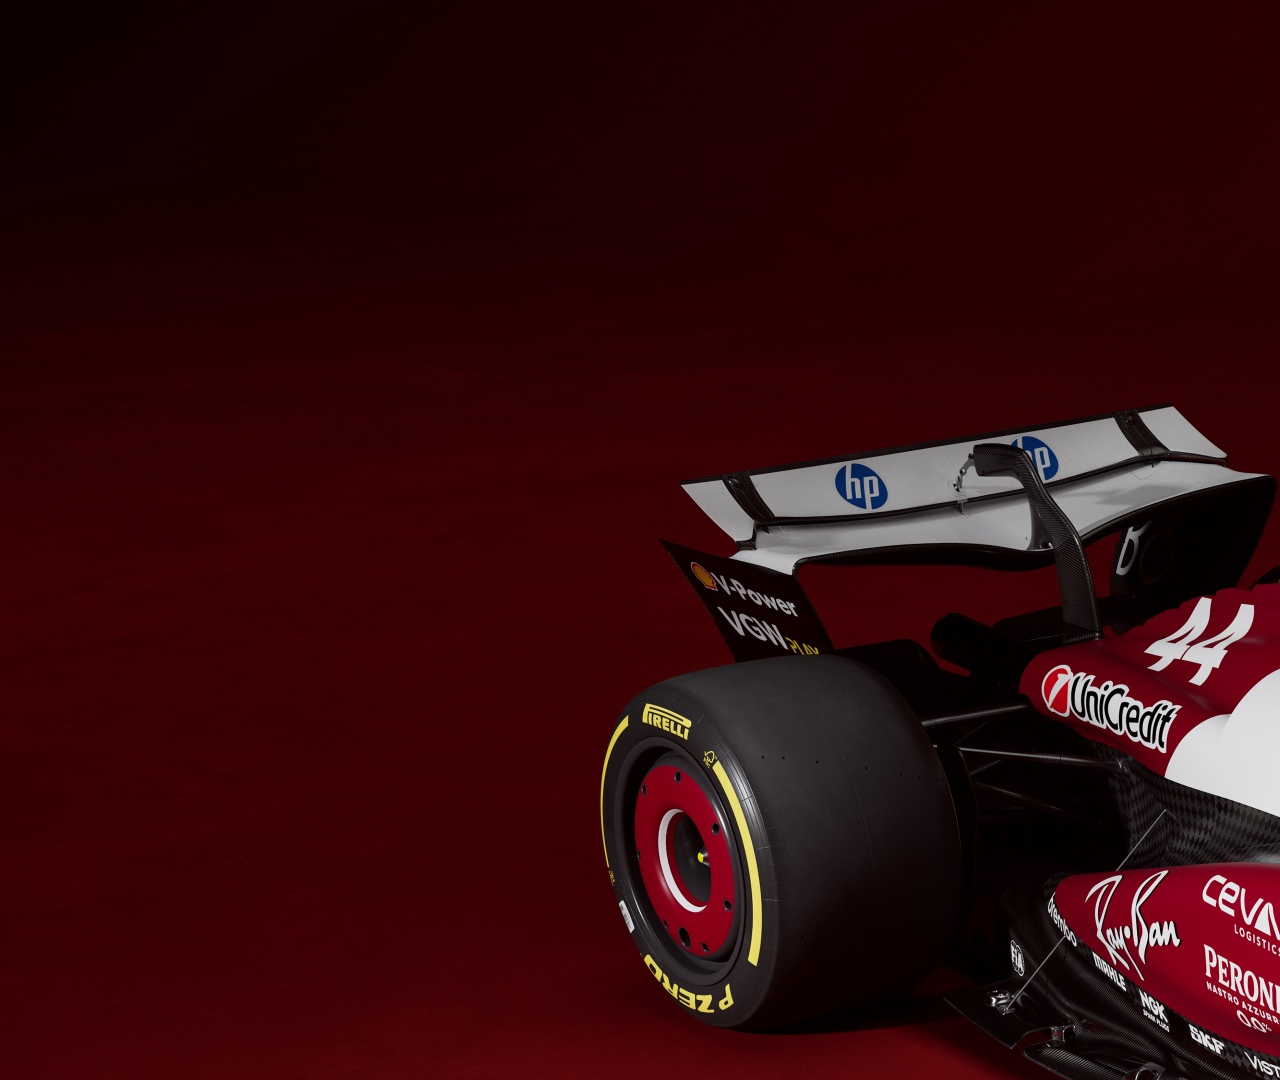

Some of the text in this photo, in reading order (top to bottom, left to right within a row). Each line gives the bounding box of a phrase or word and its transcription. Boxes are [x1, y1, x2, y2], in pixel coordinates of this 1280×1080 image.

[845, 463, 880, 510] hp
[710, 572, 799, 618] V-Power
[717, 606, 789, 650] VGW
[1144, 597, 1255, 686] 44
[642, 703, 692, 740] PIRELLI
[1070, 674, 1178, 749] UniCredit
[643, 953, 734, 1013] P ZERO
[1206, 981, 1239, 1006] NASTRO
[1139, 988, 1169, 1024] NGK
[1188, 1024, 1225, 1054] SKF
